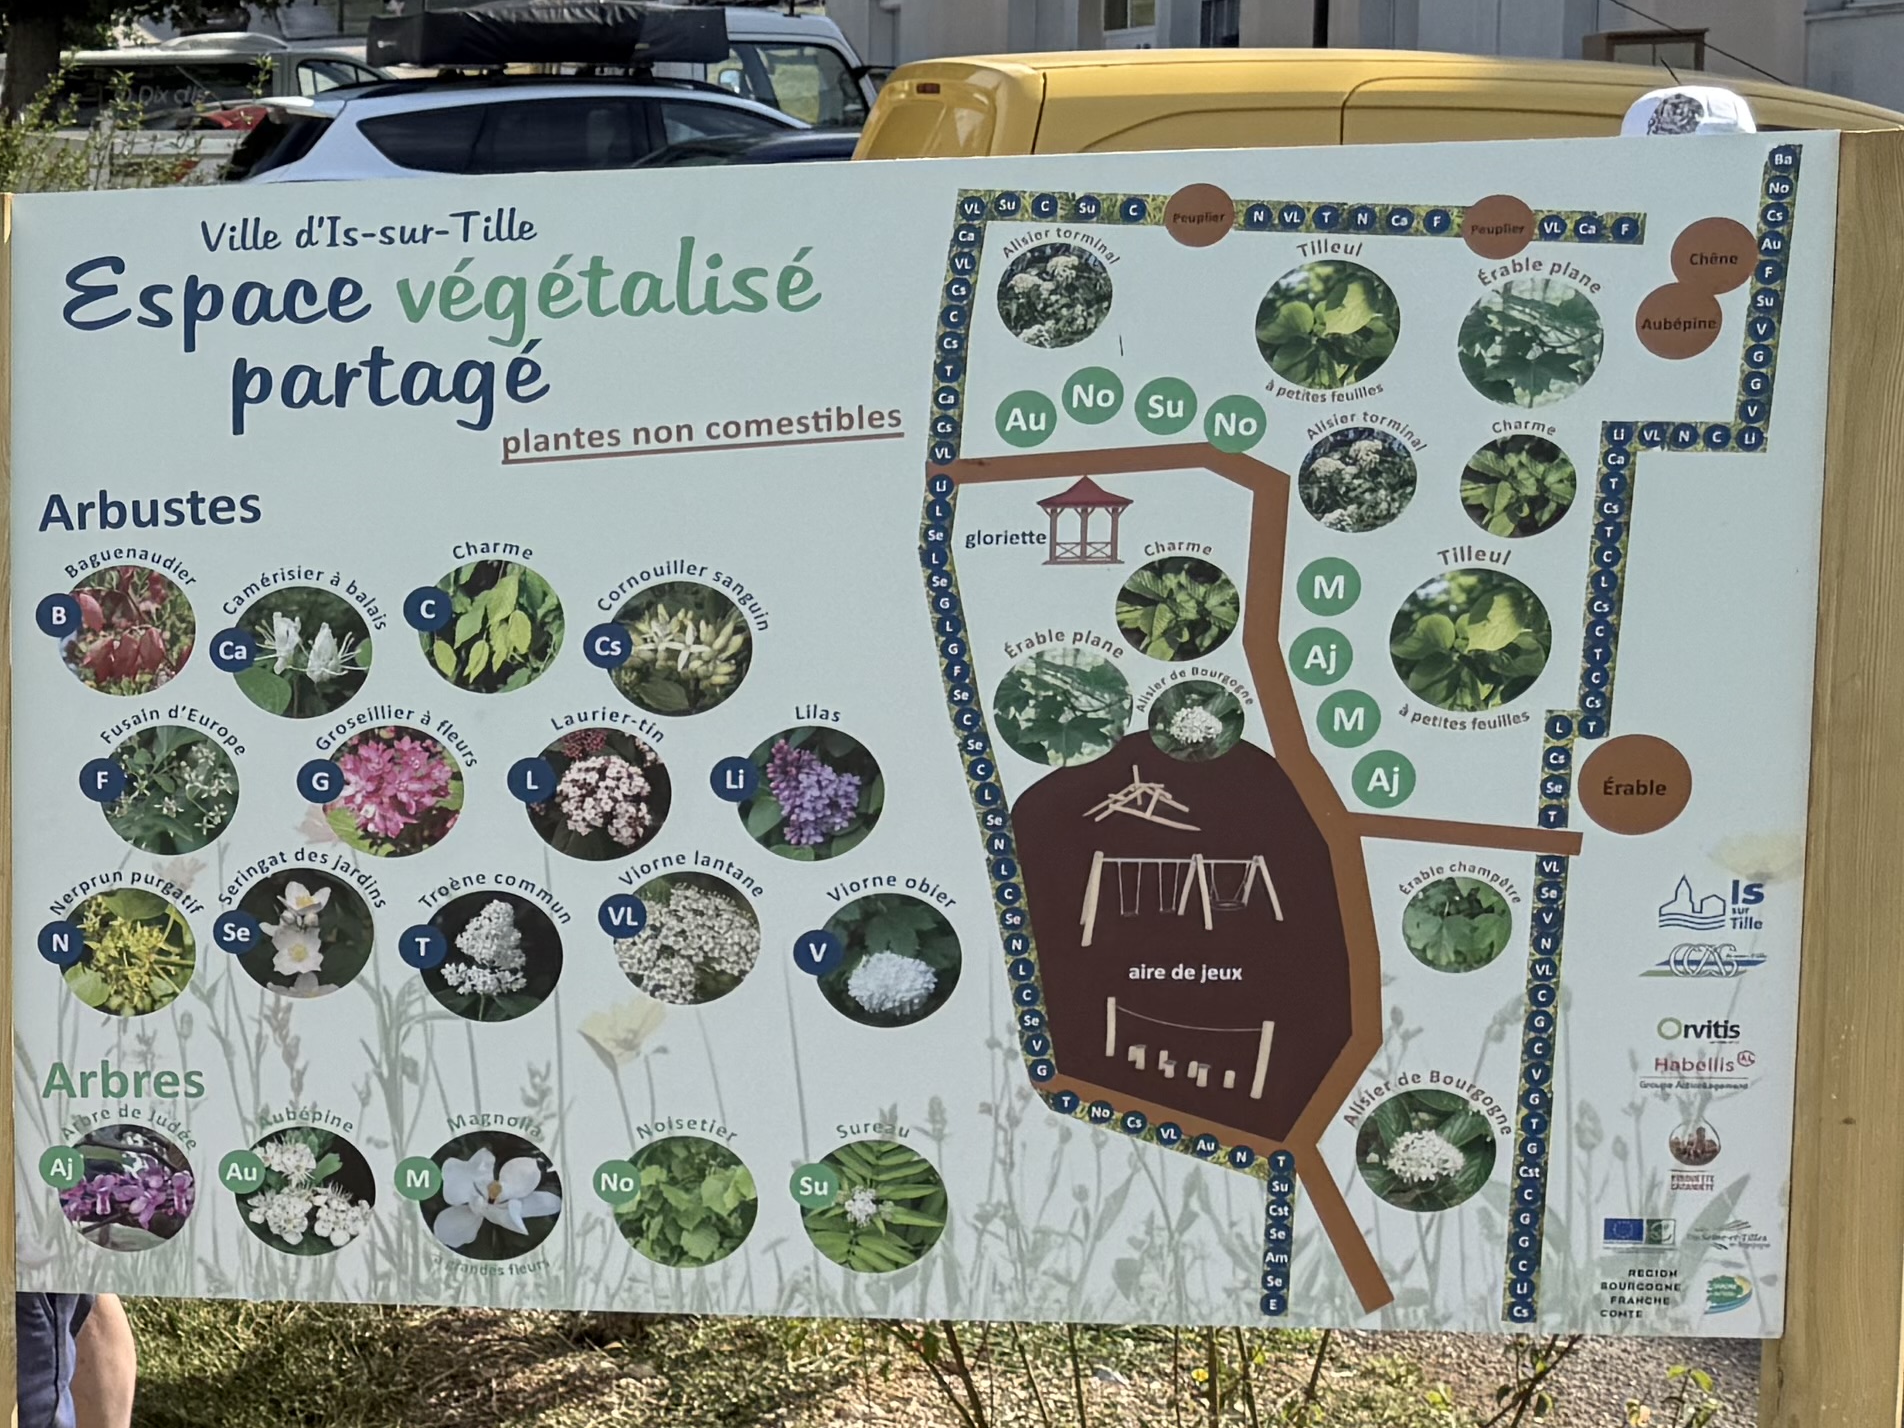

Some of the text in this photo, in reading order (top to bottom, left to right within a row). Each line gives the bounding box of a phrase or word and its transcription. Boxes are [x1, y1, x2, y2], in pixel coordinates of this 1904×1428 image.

[1774, 153, 1793, 166] Ba
[964, 202, 980, 215] VL
[999, 198, 1016, 212] Su
[1172, 211, 1226, 225] Peuplier
[1283, 211, 1301, 223] VL
[1767, 210, 1784, 222] Cs
[200, 207, 538, 253] Ville d'Is-sur-Tille
[1543, 221, 1561, 235] VL
[1579, 221, 1596, 236] Ca
[1002, 226, 1121, 266] Alisier torminal
[1296, 239, 1363, 259] Tilleul
[1761, 238, 1782, 250] Au
[1689, 251, 1739, 267] Chêne
[1477, 257, 1603, 296] Érable plane
[62, 236, 823, 353] Espace végétalisé
[1757, 294, 1774, 308] Su
[1641, 315, 1718, 334] Aubépine
[231, 338, 551, 435] partagé
[1072, 384, 1115, 409] No
[1276, 385, 1327, 404] petites
[1330, 381, 1384, 404] feuilles
[1147, 395, 1184, 419] Su
[1005, 408, 1046, 432] Au
[1213, 412, 1258, 438] No
[1491, 420, 1558, 437] Charme
[502, 404, 903, 459] plantes non comestibles
[1306, 411, 1428, 452] Alisier torminal
[38, 489, 262, 532] Arbustes
[965, 529, 1047, 548] gloriette
[1144, 541, 1212, 557] Charme
[452, 541, 534, 561] Charme
[1437, 545, 1512, 566] Tilleul
[63, 547, 197, 586] Baguenaudier
[597, 559, 769, 632] Cornouiller sanguin
[1313, 575, 1344, 600] M
[222, 565, 387, 632] Camérisier à balais
[420, 599, 436, 619] C
[52, 607, 67, 624] B
[218, 641, 248, 661] Ca
[594, 636, 622, 657] Cs
[1004, 629, 1125, 659] Érable plane
[1304, 644, 1337, 675] Aj
[1169, 666, 1187, 681] de
[1190, 666, 1254, 707] Bourgogne
[795, 704, 842, 723] Lilas
[1333, 706, 1365, 732] M
[1410, 711, 1468, 731] petites
[1471, 710, 1530, 730] feuilles
[99, 704, 247, 756] Fusain d'Europe
[315, 704, 478, 768] Groseillier à fleurs
[550, 707, 665, 744] Laurier-tin
[96, 771, 109, 790] F
[311, 771, 330, 791] G
[526, 770, 538, 790] L
[725, 769, 745, 790] Li
[1367, 767, 1400, 797] Aj
[1603, 778, 1668, 797] Érable
[217, 847, 387, 910] Seringat des jardins
[617, 850, 765, 901] Viorne lantane
[1398, 861, 1521, 905] Érable champêtre
[49, 870, 205, 917] Nerprun purgatif
[418, 871, 573, 927] Troène commun
[826, 873, 957, 911] Viorne obier
[1732, 879, 1765, 905] Is
[608, 906, 639, 927] VL
[1732, 907, 1749, 915] sur
[222, 923, 250, 942] Se
[1730, 917, 1763, 930] Tille
[52, 934, 69, 952] N
[415, 938, 431, 957] T
[809, 943, 828, 963] V
[1128, 962, 1243, 984] aire de jeux
[1657, 1017, 1741, 1040] Orvitis
[1655, 1057, 1735, 1072] Habellis
[42, 1059, 206, 1099] Arbres
[1091, 1107, 1110, 1119] No
[1343, 1070, 1512, 1136] Alisier de Bourgogne
[61, 1103, 197, 1150] Arbre de Judée
[259, 1108, 354, 1133] Aubépine
[446, 1113, 544, 1139] Magnolia
[636, 1115, 739, 1143] Noisetier
[835, 1121, 911, 1139] Sureau
[1197, 1140, 1215, 1152] Au
[50, 1160, 73, 1181] Aj
[225, 1162, 257, 1182] Au
[406, 1169, 430, 1188] M
[600, 1172, 635, 1193] No
[799, 1176, 829, 1196] Su
[1273, 1180, 1289, 1193] Su
[1269, 1205, 1290, 1217] Cst
[1265, 1252, 1289, 1264] Am
[1600, 1282, 1681, 1292] BOURGOGNE
[1610, 1296, 1671, 1306] FRANCHE
